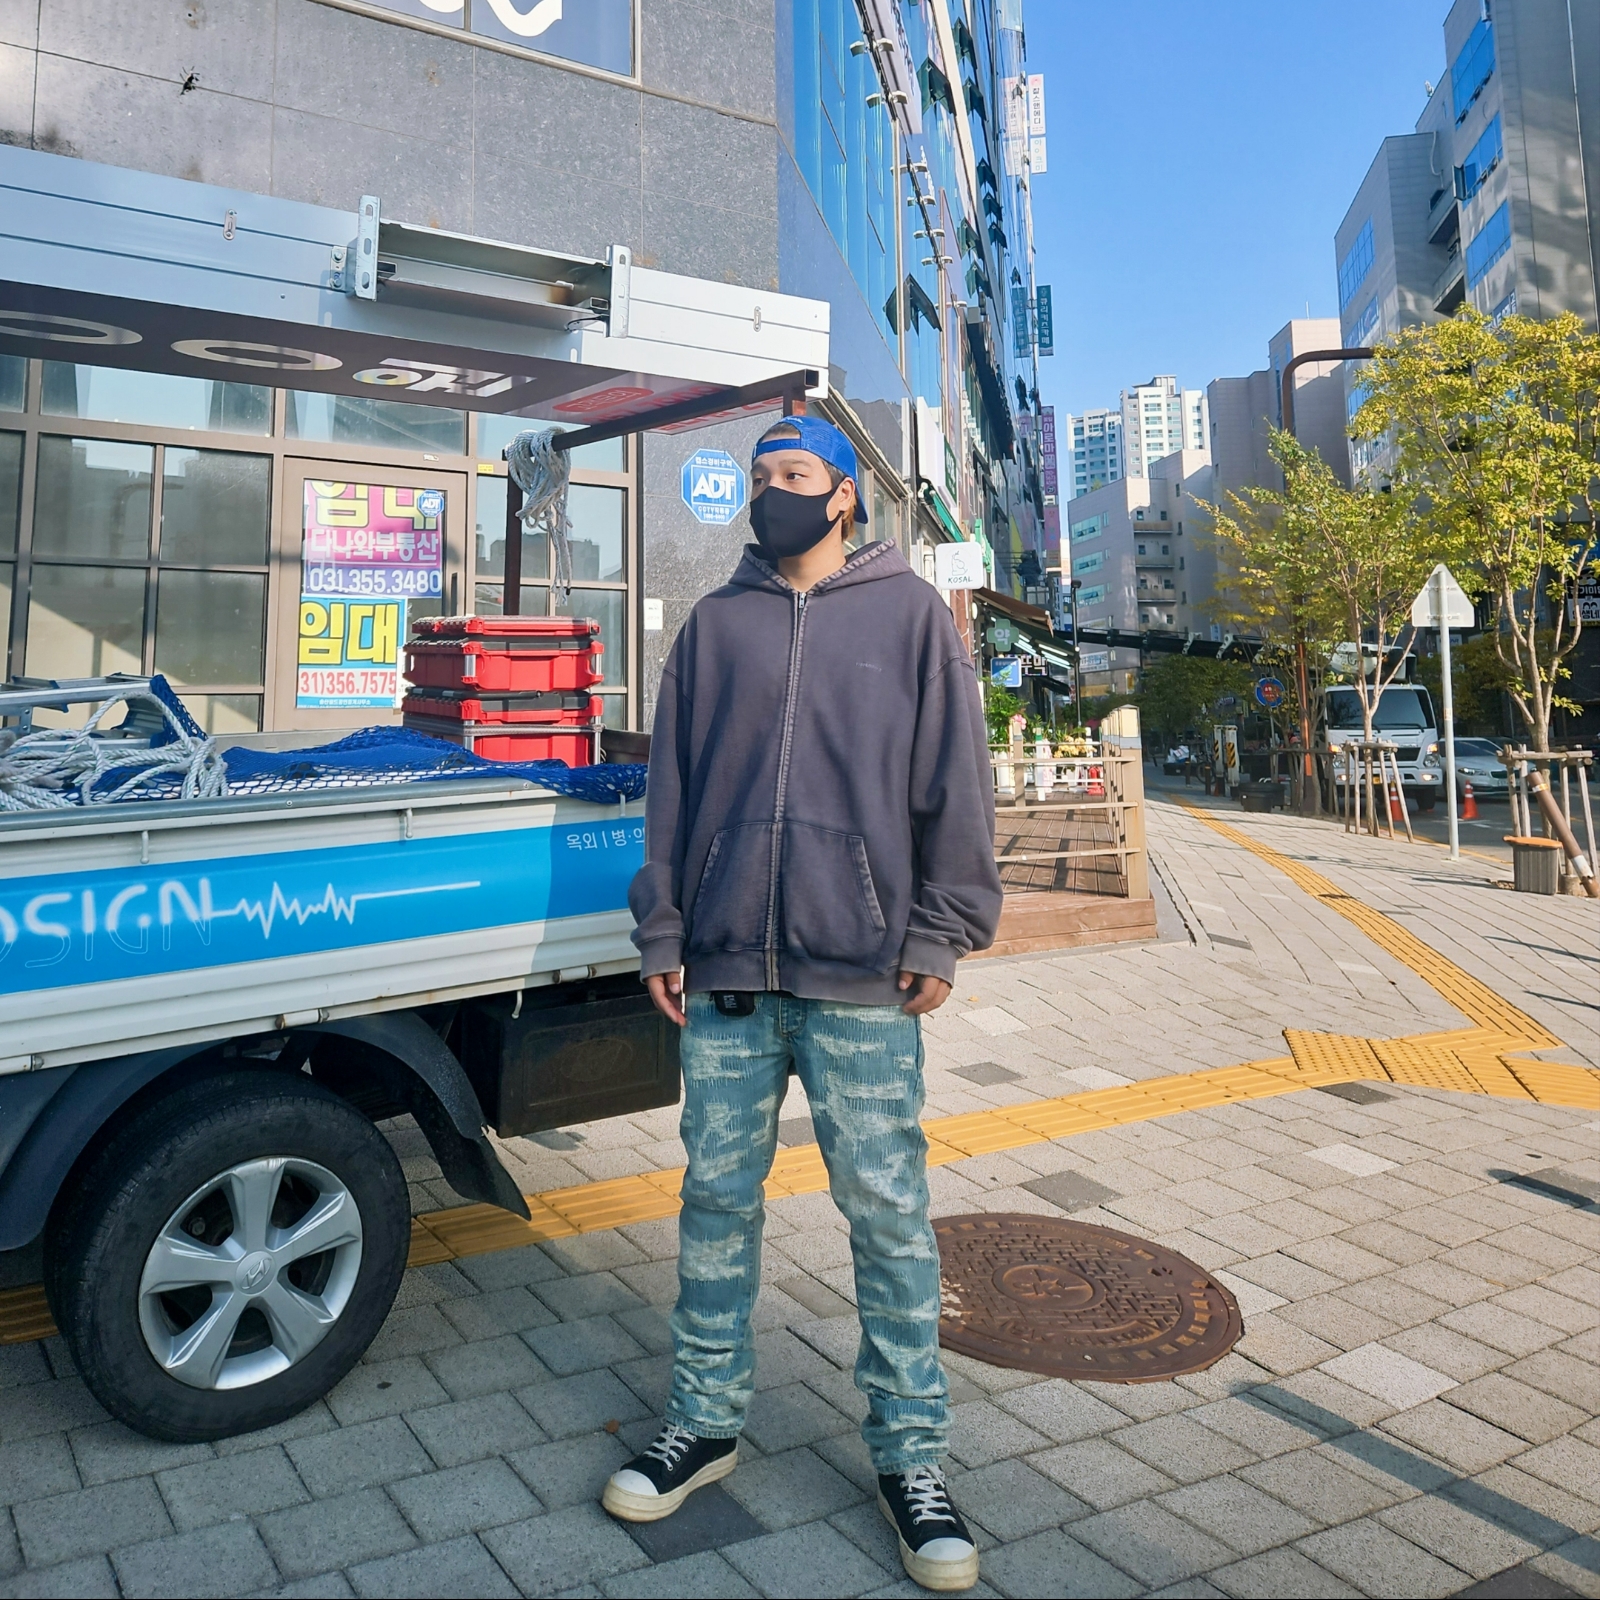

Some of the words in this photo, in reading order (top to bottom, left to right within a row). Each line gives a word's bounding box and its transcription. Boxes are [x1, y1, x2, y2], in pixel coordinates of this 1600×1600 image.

[1043, 422, 1055, 453] 아로마
[693, 472, 736, 500] ADT
[421, 498, 441, 510] ADT
[310, 528, 440, 561] 다나와부동산
[309, 568, 442, 593] 031.355.3480
[299, 601, 399, 665] 임대
[994, 628, 1011, 645] 약
[566, 832, 598, 850] 옥외
